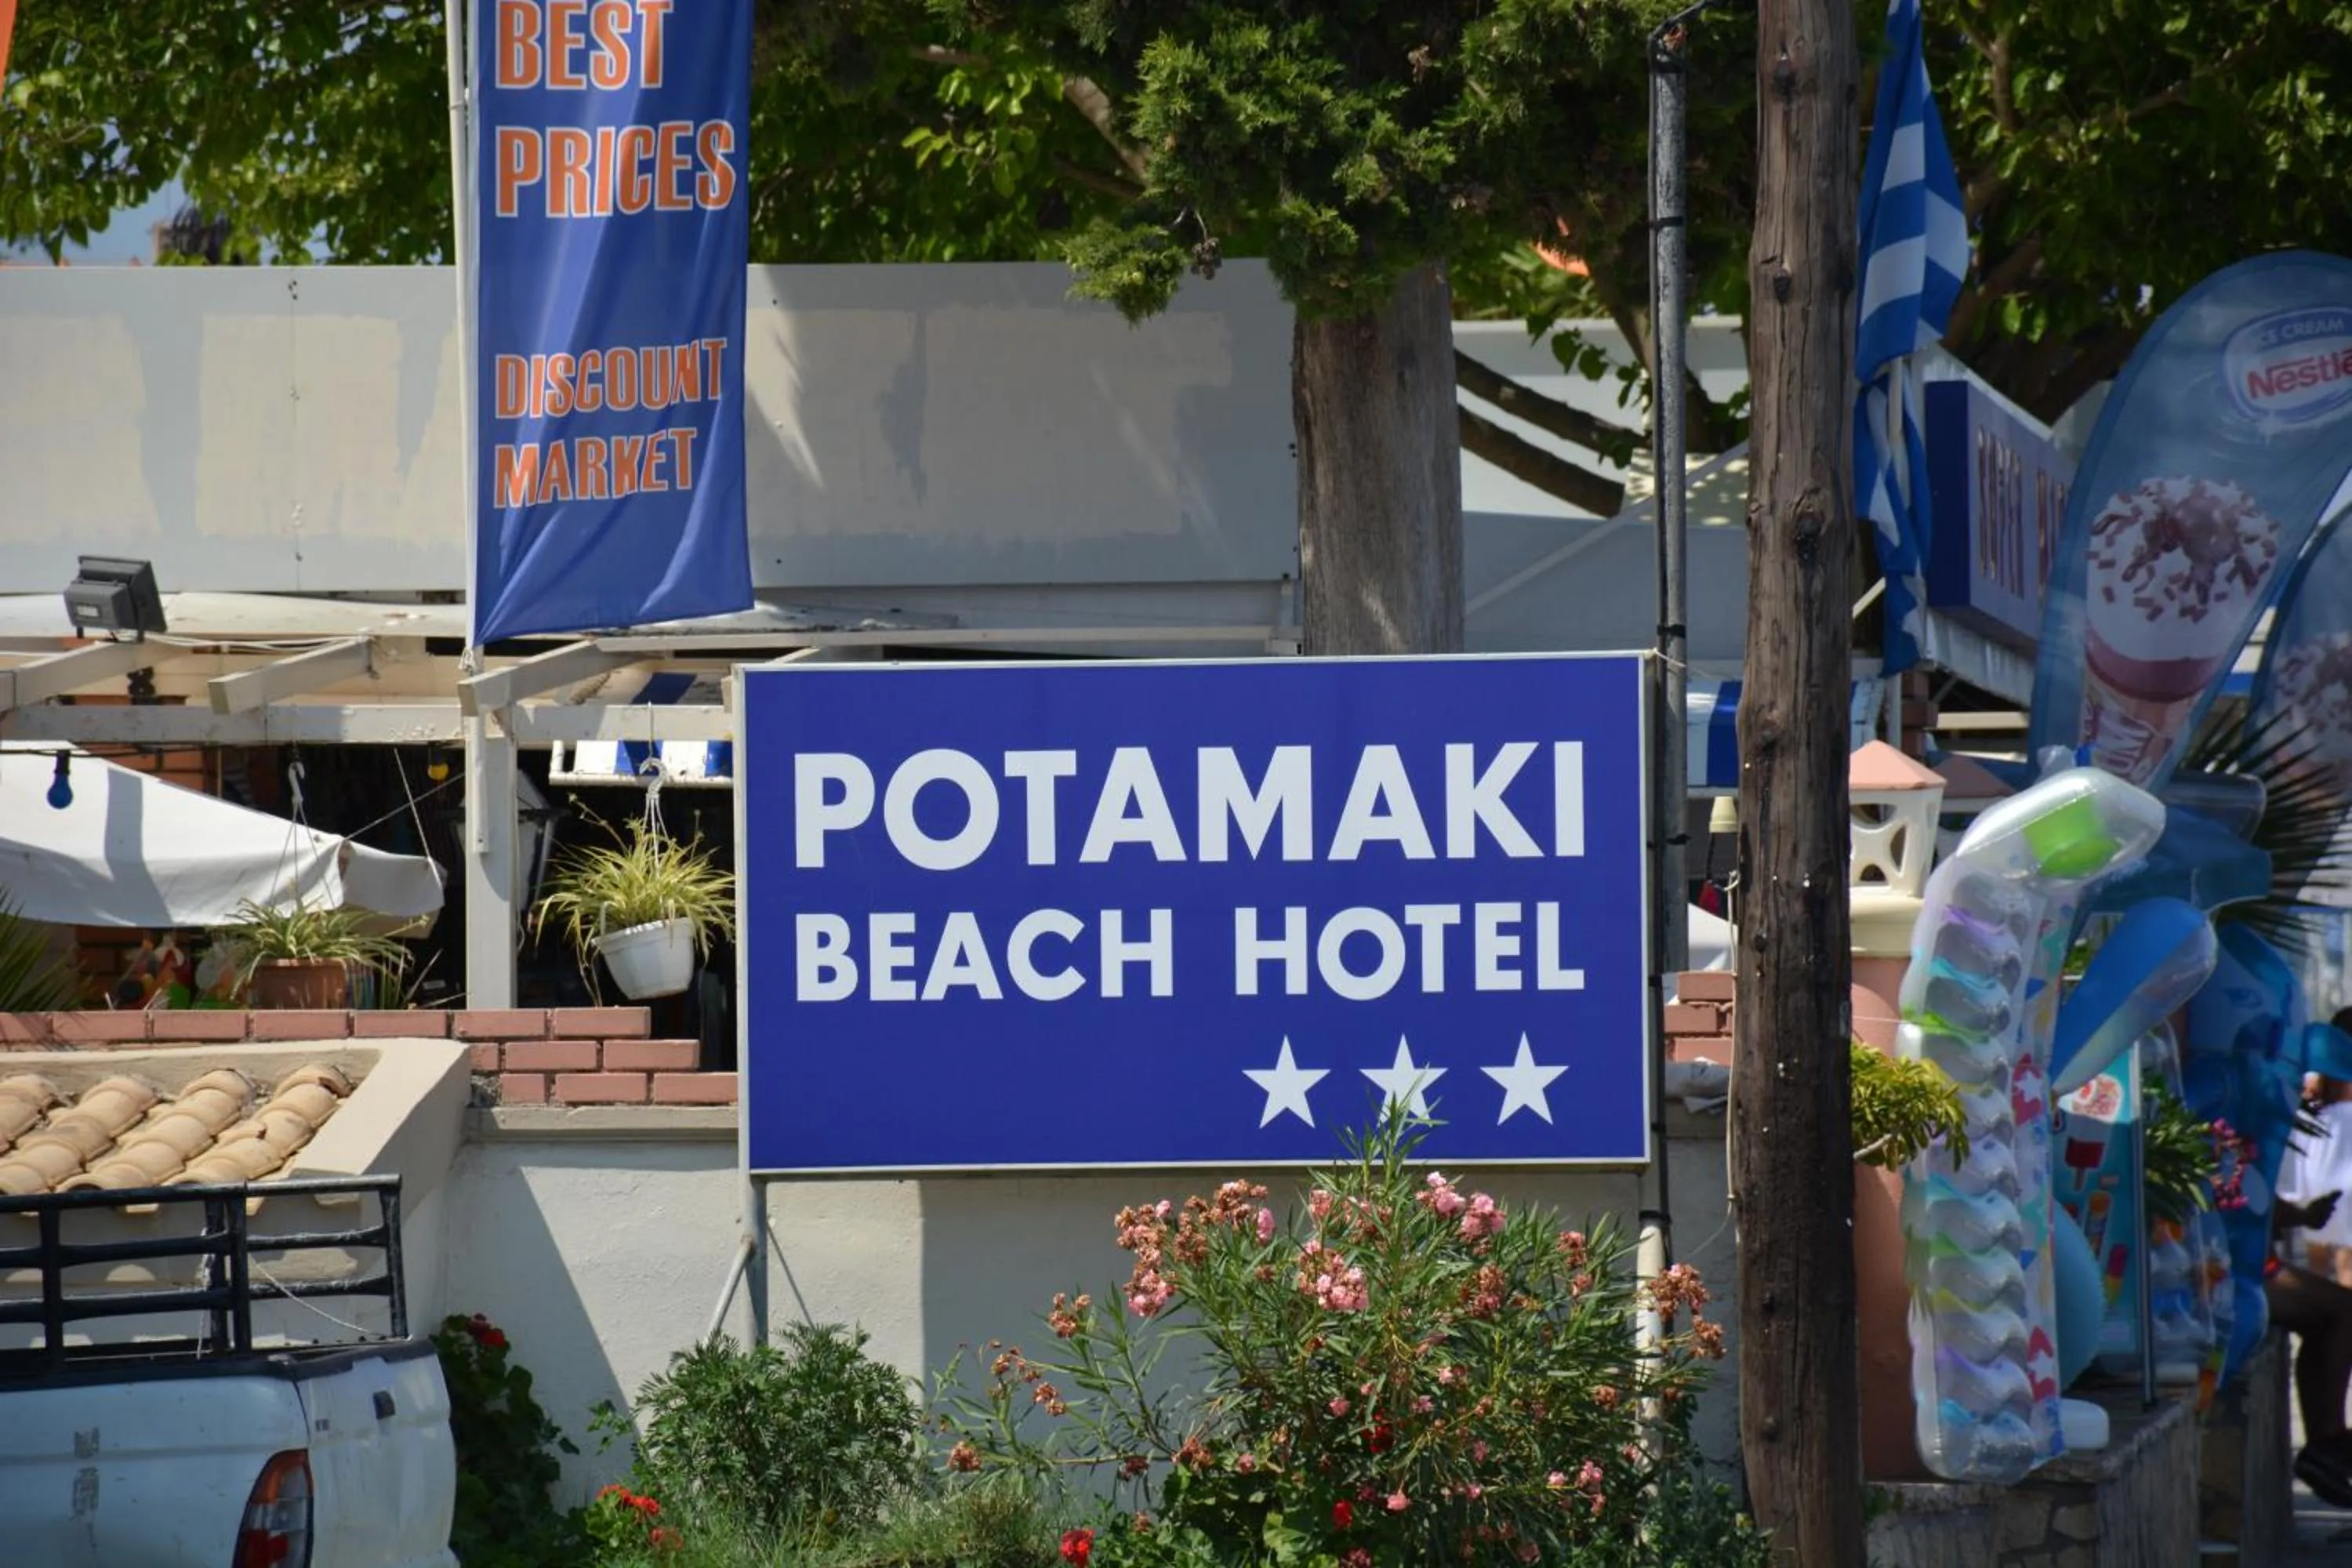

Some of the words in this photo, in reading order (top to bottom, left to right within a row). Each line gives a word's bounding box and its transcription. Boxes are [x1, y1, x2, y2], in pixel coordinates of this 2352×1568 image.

[495, 0, 674, 90] BEST
[495, 120, 736, 217] PRICES
[495, 338, 727, 418] DISCOUNT
[494, 427, 697, 508] MARKET
[793, 740, 1584, 871] POTAMAKI
[796, 909, 1174, 1002] BEACH
[1235, 901, 1584, 1000] HOTEL
